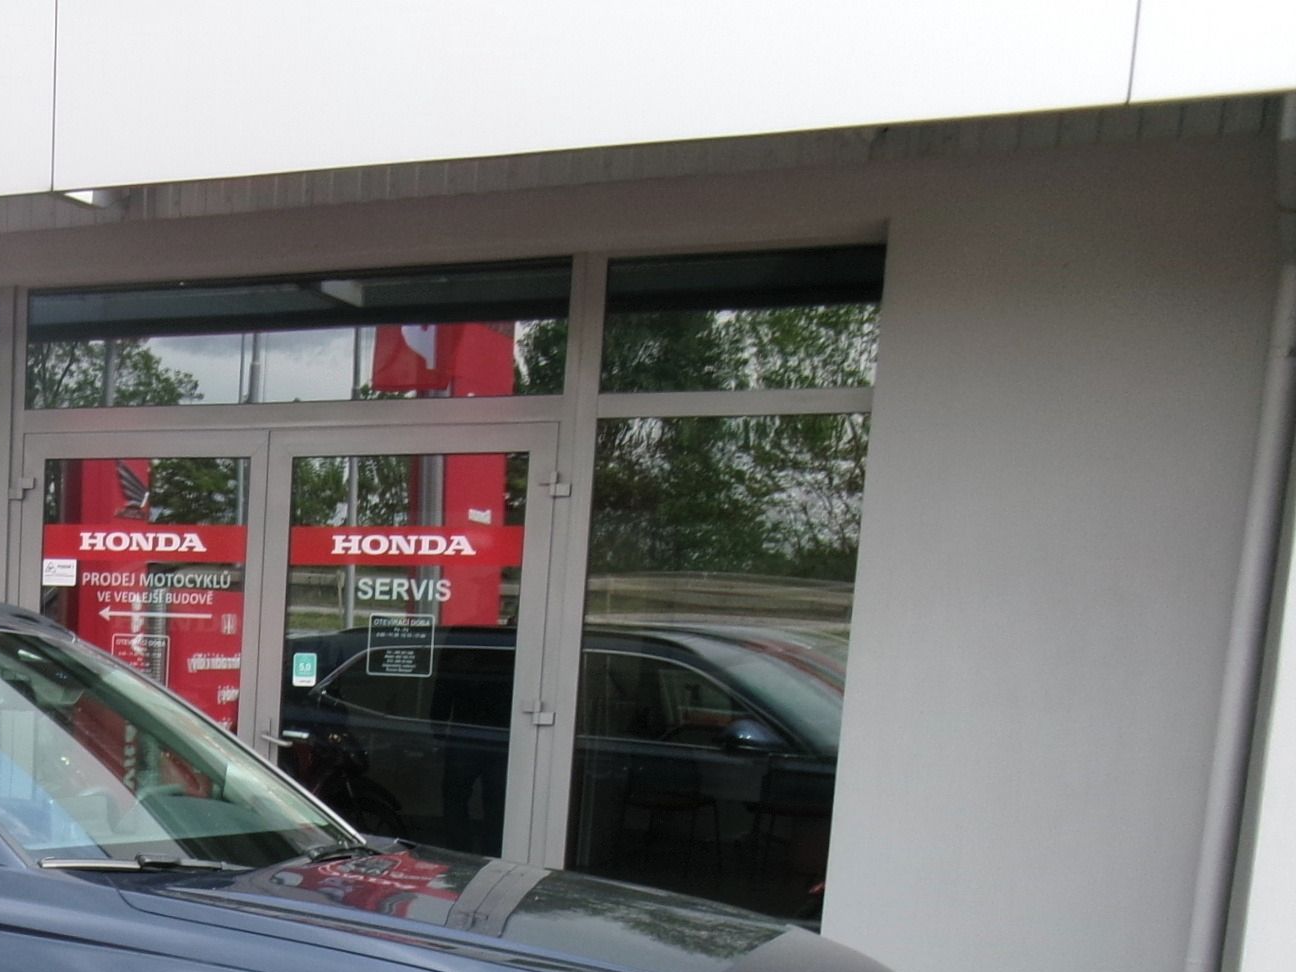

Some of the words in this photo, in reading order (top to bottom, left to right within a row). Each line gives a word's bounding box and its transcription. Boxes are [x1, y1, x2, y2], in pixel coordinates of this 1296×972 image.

[79, 532, 207, 552] HONDA
[331, 535, 477, 556] HONDA
[82, 571, 135, 587] PRODEJ
[139, 570, 232, 589] MOTOCYKLŮ
[357, 577, 451, 601] SERVIS
[97, 591, 111, 602] VE
[165, 590, 214, 605] BUDOVĚ
